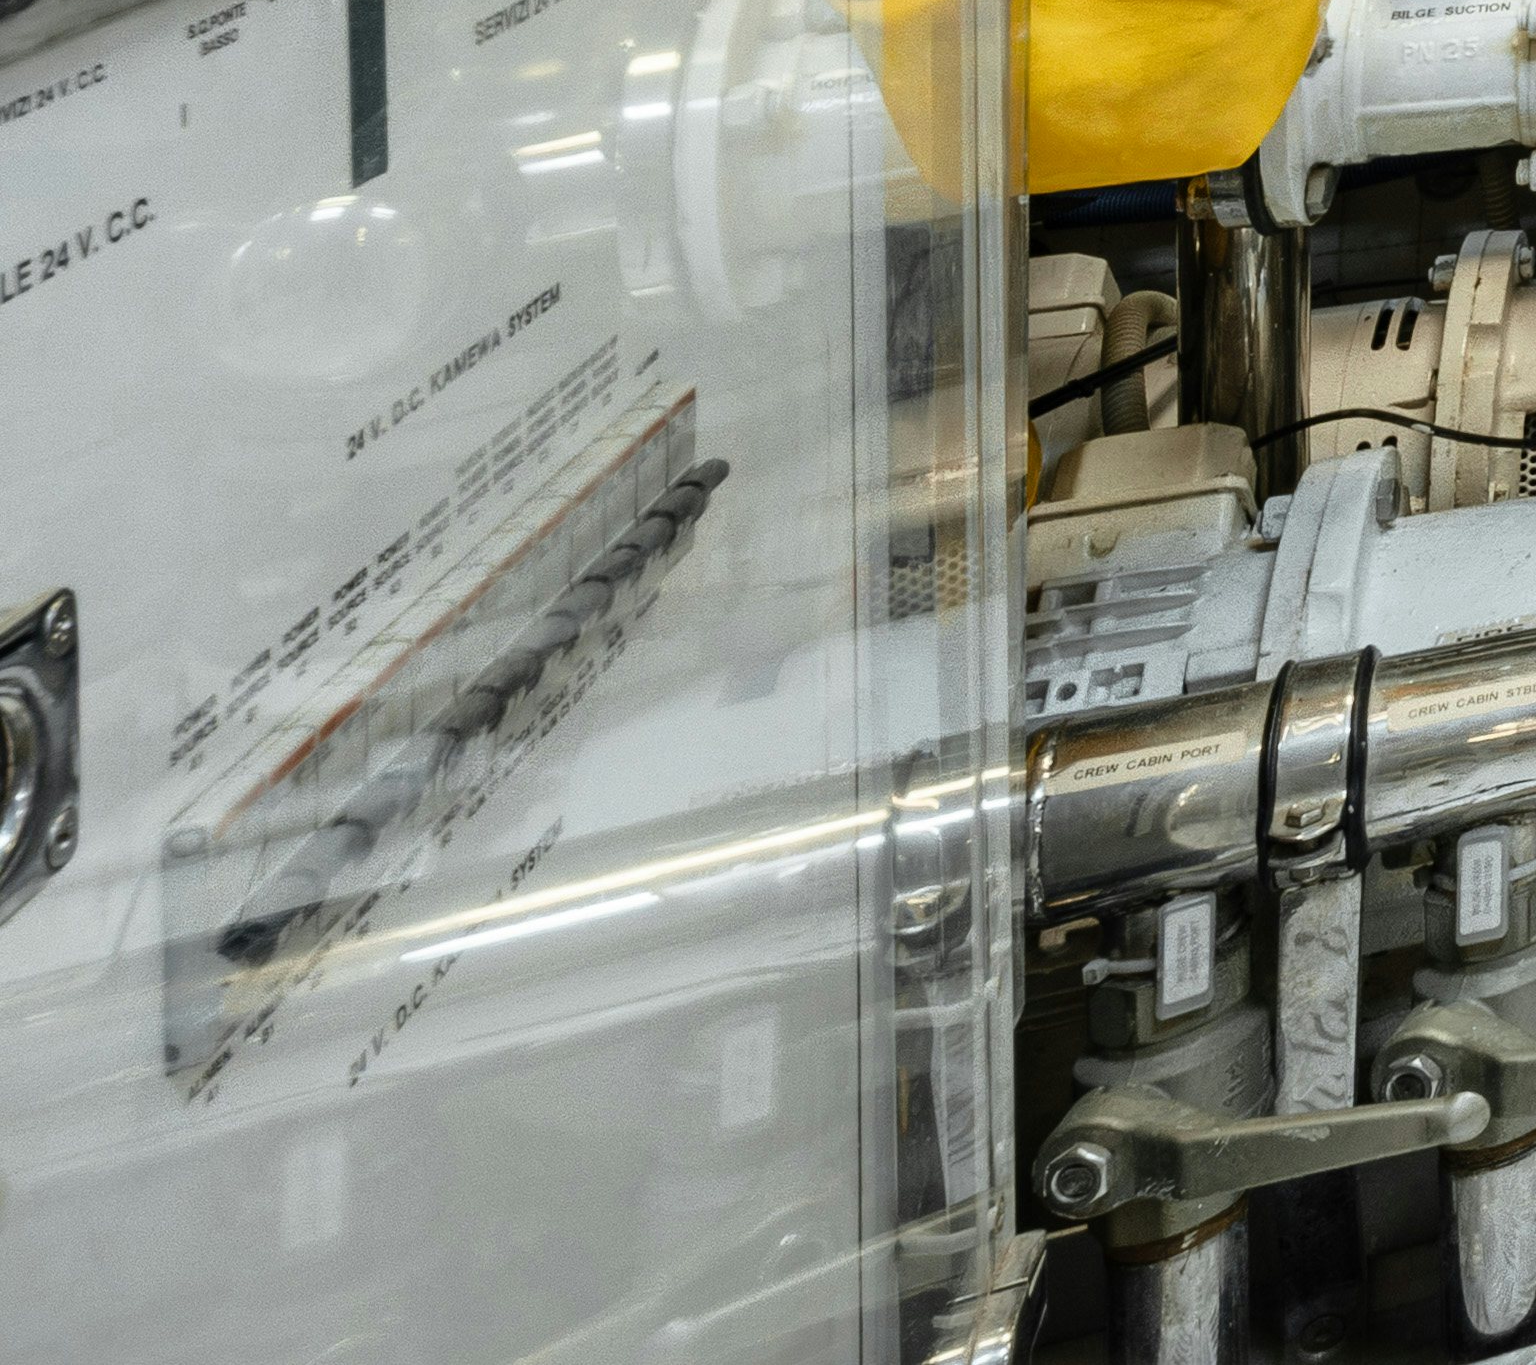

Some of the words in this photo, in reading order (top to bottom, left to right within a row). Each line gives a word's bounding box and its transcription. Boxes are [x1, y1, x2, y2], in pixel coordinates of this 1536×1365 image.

[1390, 6, 1437, 22] BILGE
[1443, 1, 1513, 18] SUCTION
[36, 81, 55, 109] 24
[77, 62, 109, 92] C.C.
[39, 240, 71, 284] 24
[75, 225, 100, 260] V.
[105, 196, 157, 244] C.C.
[507, 281, 561, 339] SYSTEM
[1407, 701, 1451, 721] CREW
[1455, 690, 1501, 710] CABIN
[1073, 763, 1120, 781] CREW
[1126, 752, 1174, 772] CABIN
[1180, 742, 1223, 761] PORT
